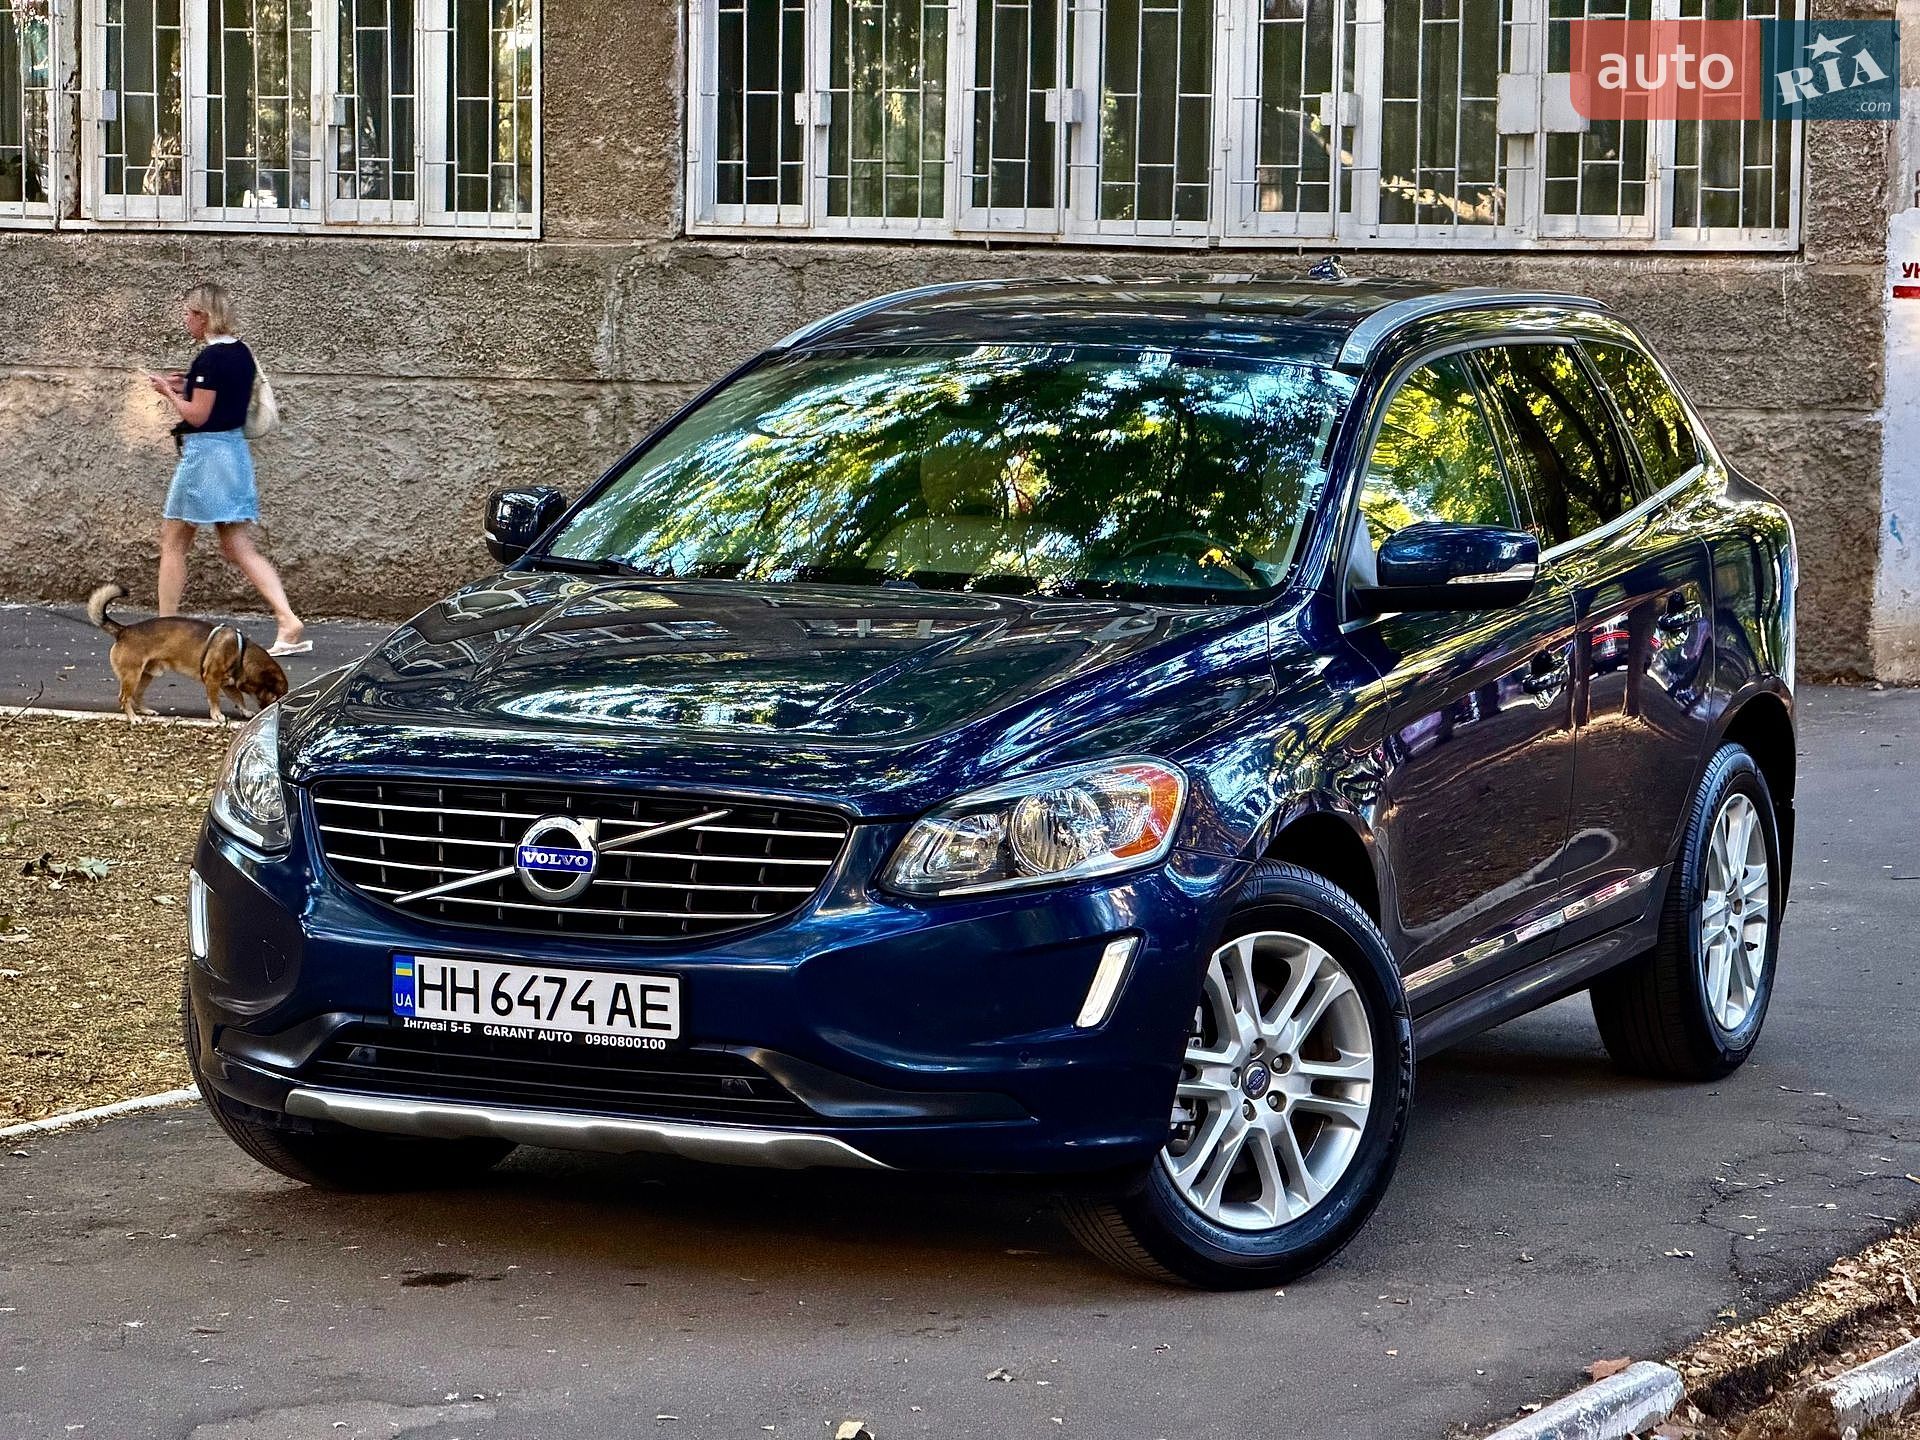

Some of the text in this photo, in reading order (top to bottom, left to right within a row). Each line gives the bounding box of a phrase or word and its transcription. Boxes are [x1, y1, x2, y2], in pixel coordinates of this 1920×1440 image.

[522, 852, 589, 866] VOLVO
[395, 993, 413, 1007] UA
[491, 972, 595, 1025] 6474
[483, 1025, 666, 1050] GARANT AUTO 0980800100
